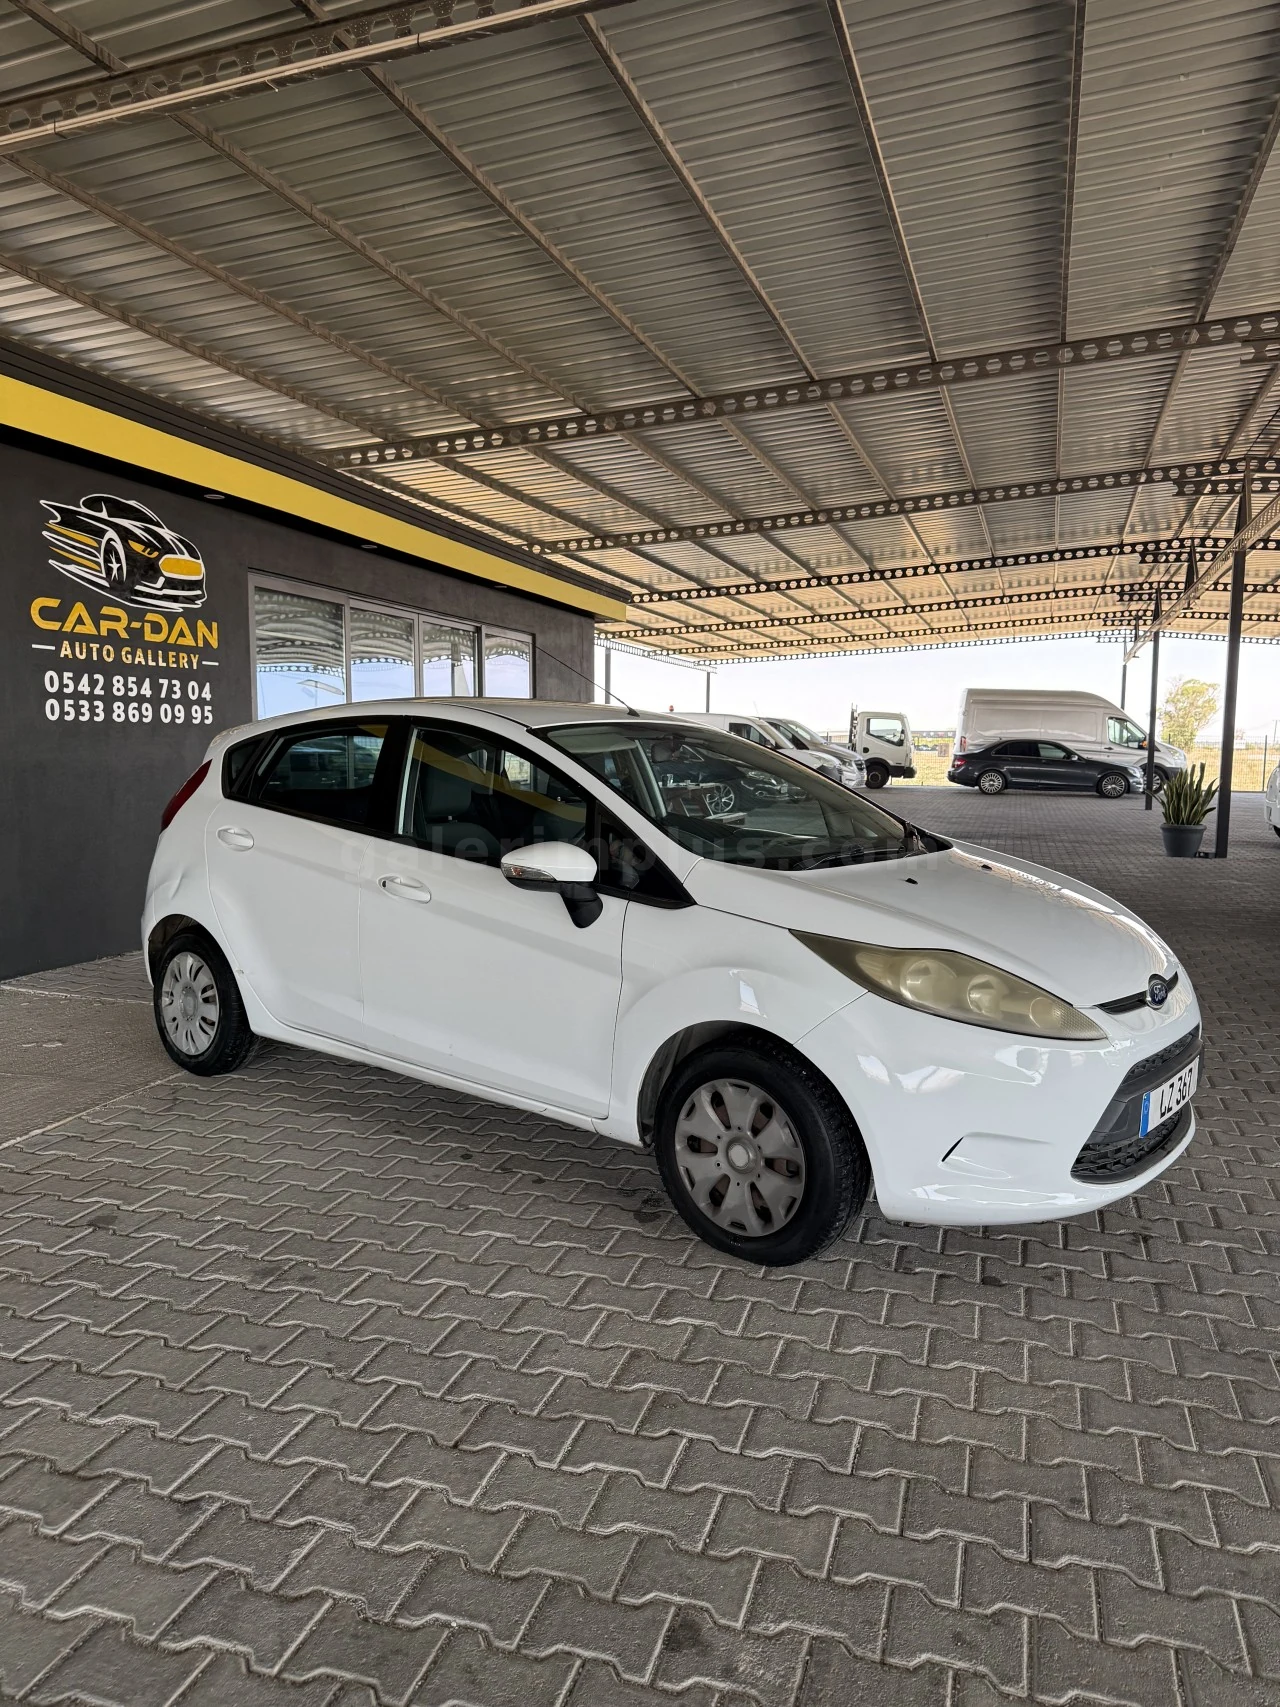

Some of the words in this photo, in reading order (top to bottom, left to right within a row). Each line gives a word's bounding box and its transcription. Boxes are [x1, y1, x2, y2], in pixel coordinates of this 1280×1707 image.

[30, 596, 219, 650] CAR-DAN
[60, 640, 115, 662] AUTO
[121, 649, 199, 670] GALLERY
[44, 670, 105, 695] 0542
[112, 675, 153, 699] 854
[159, 678, 182, 699] 73
[188, 681, 212, 701] 04
[45, 699, 105, 722] 0533
[112, 703, 153, 723] 869
[160, 705, 185, 724] 09
[191, 705, 213, 725] 95
[1153, 985, 1167, 1002] Ford
[1159, 1081, 1175, 1119] LZ
[1176, 1067, 1193, 1105] 367
